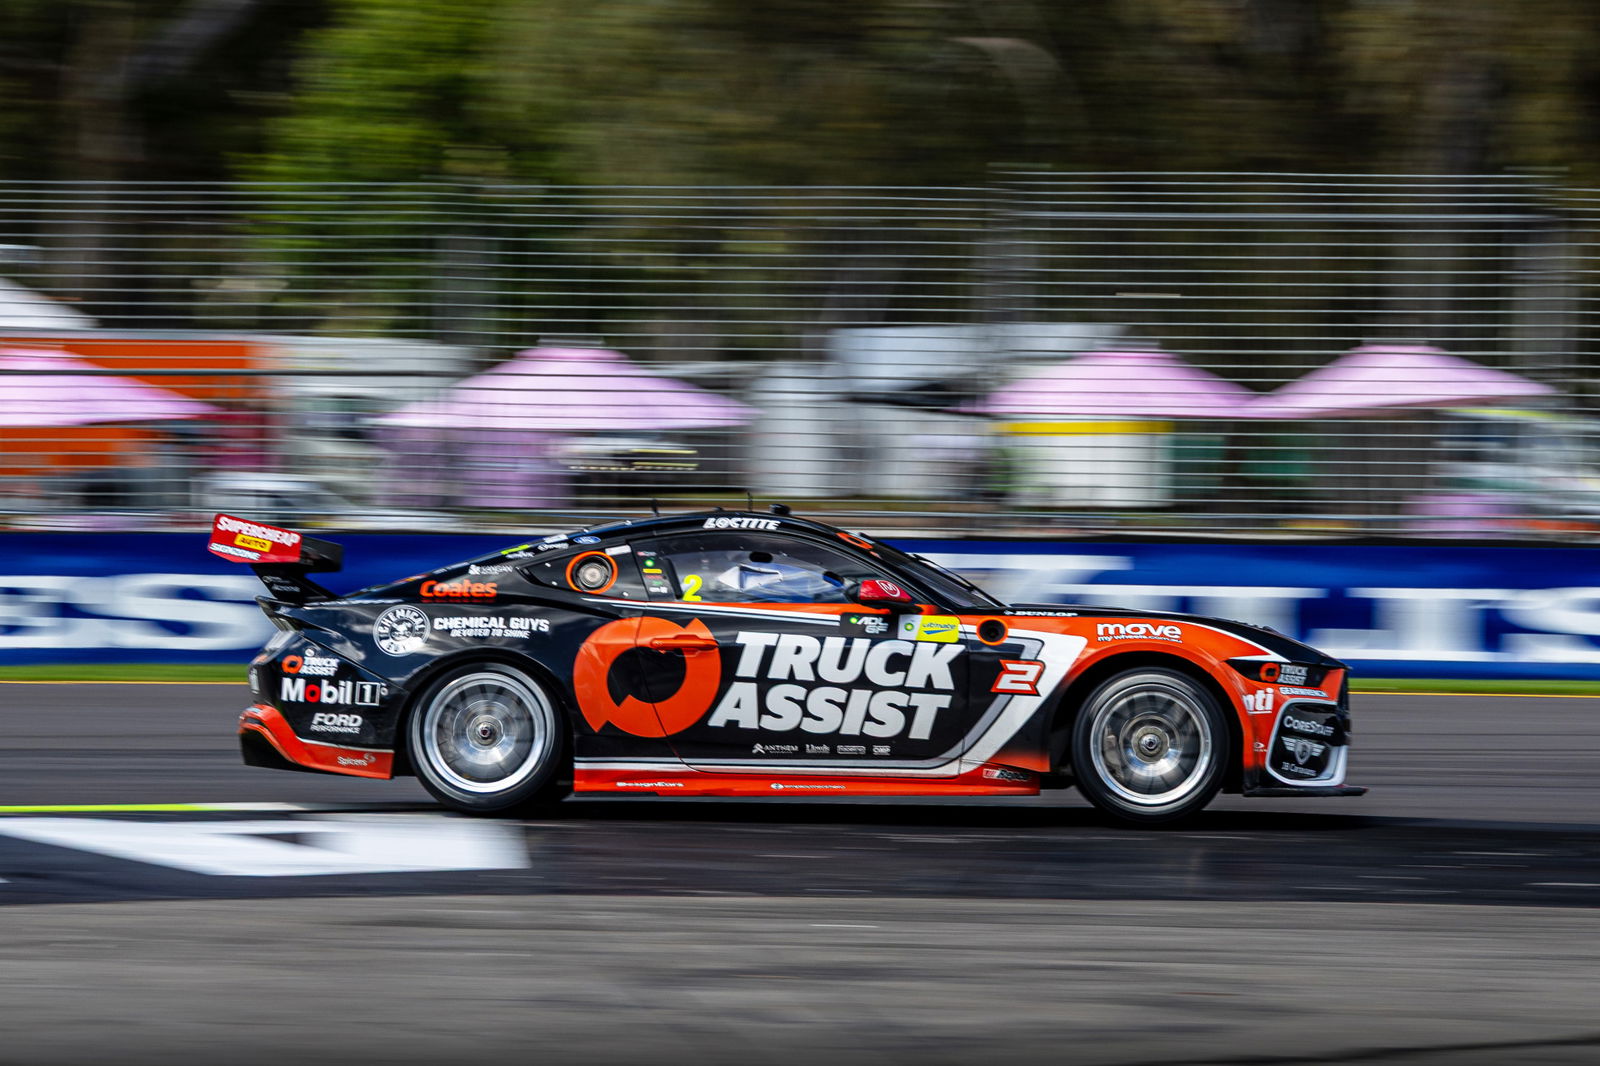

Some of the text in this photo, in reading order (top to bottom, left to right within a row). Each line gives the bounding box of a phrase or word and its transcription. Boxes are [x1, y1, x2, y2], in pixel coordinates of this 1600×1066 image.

[216, 516, 301, 547] SUPERCHEAP
[703, 517, 780, 530] LOCTITE
[420, 579, 497, 598] Coates
[682, 574, 704, 602] 2
[432, 617, 550, 632] CHEMICAL GUYS
[1097, 623, 1182, 639] move
[450, 628, 531, 639] DEVOTED TO SHINE
[304, 656, 339, 668] TRUCK
[735, 631, 965, 690] TRUCK
[990, 660, 1042, 696] 2
[1281, 664, 1307, 676] TRUCK
[281, 678, 352, 704] Mobil
[708, 682, 952, 740] ASSIST
[312, 713, 362, 727] FORD
